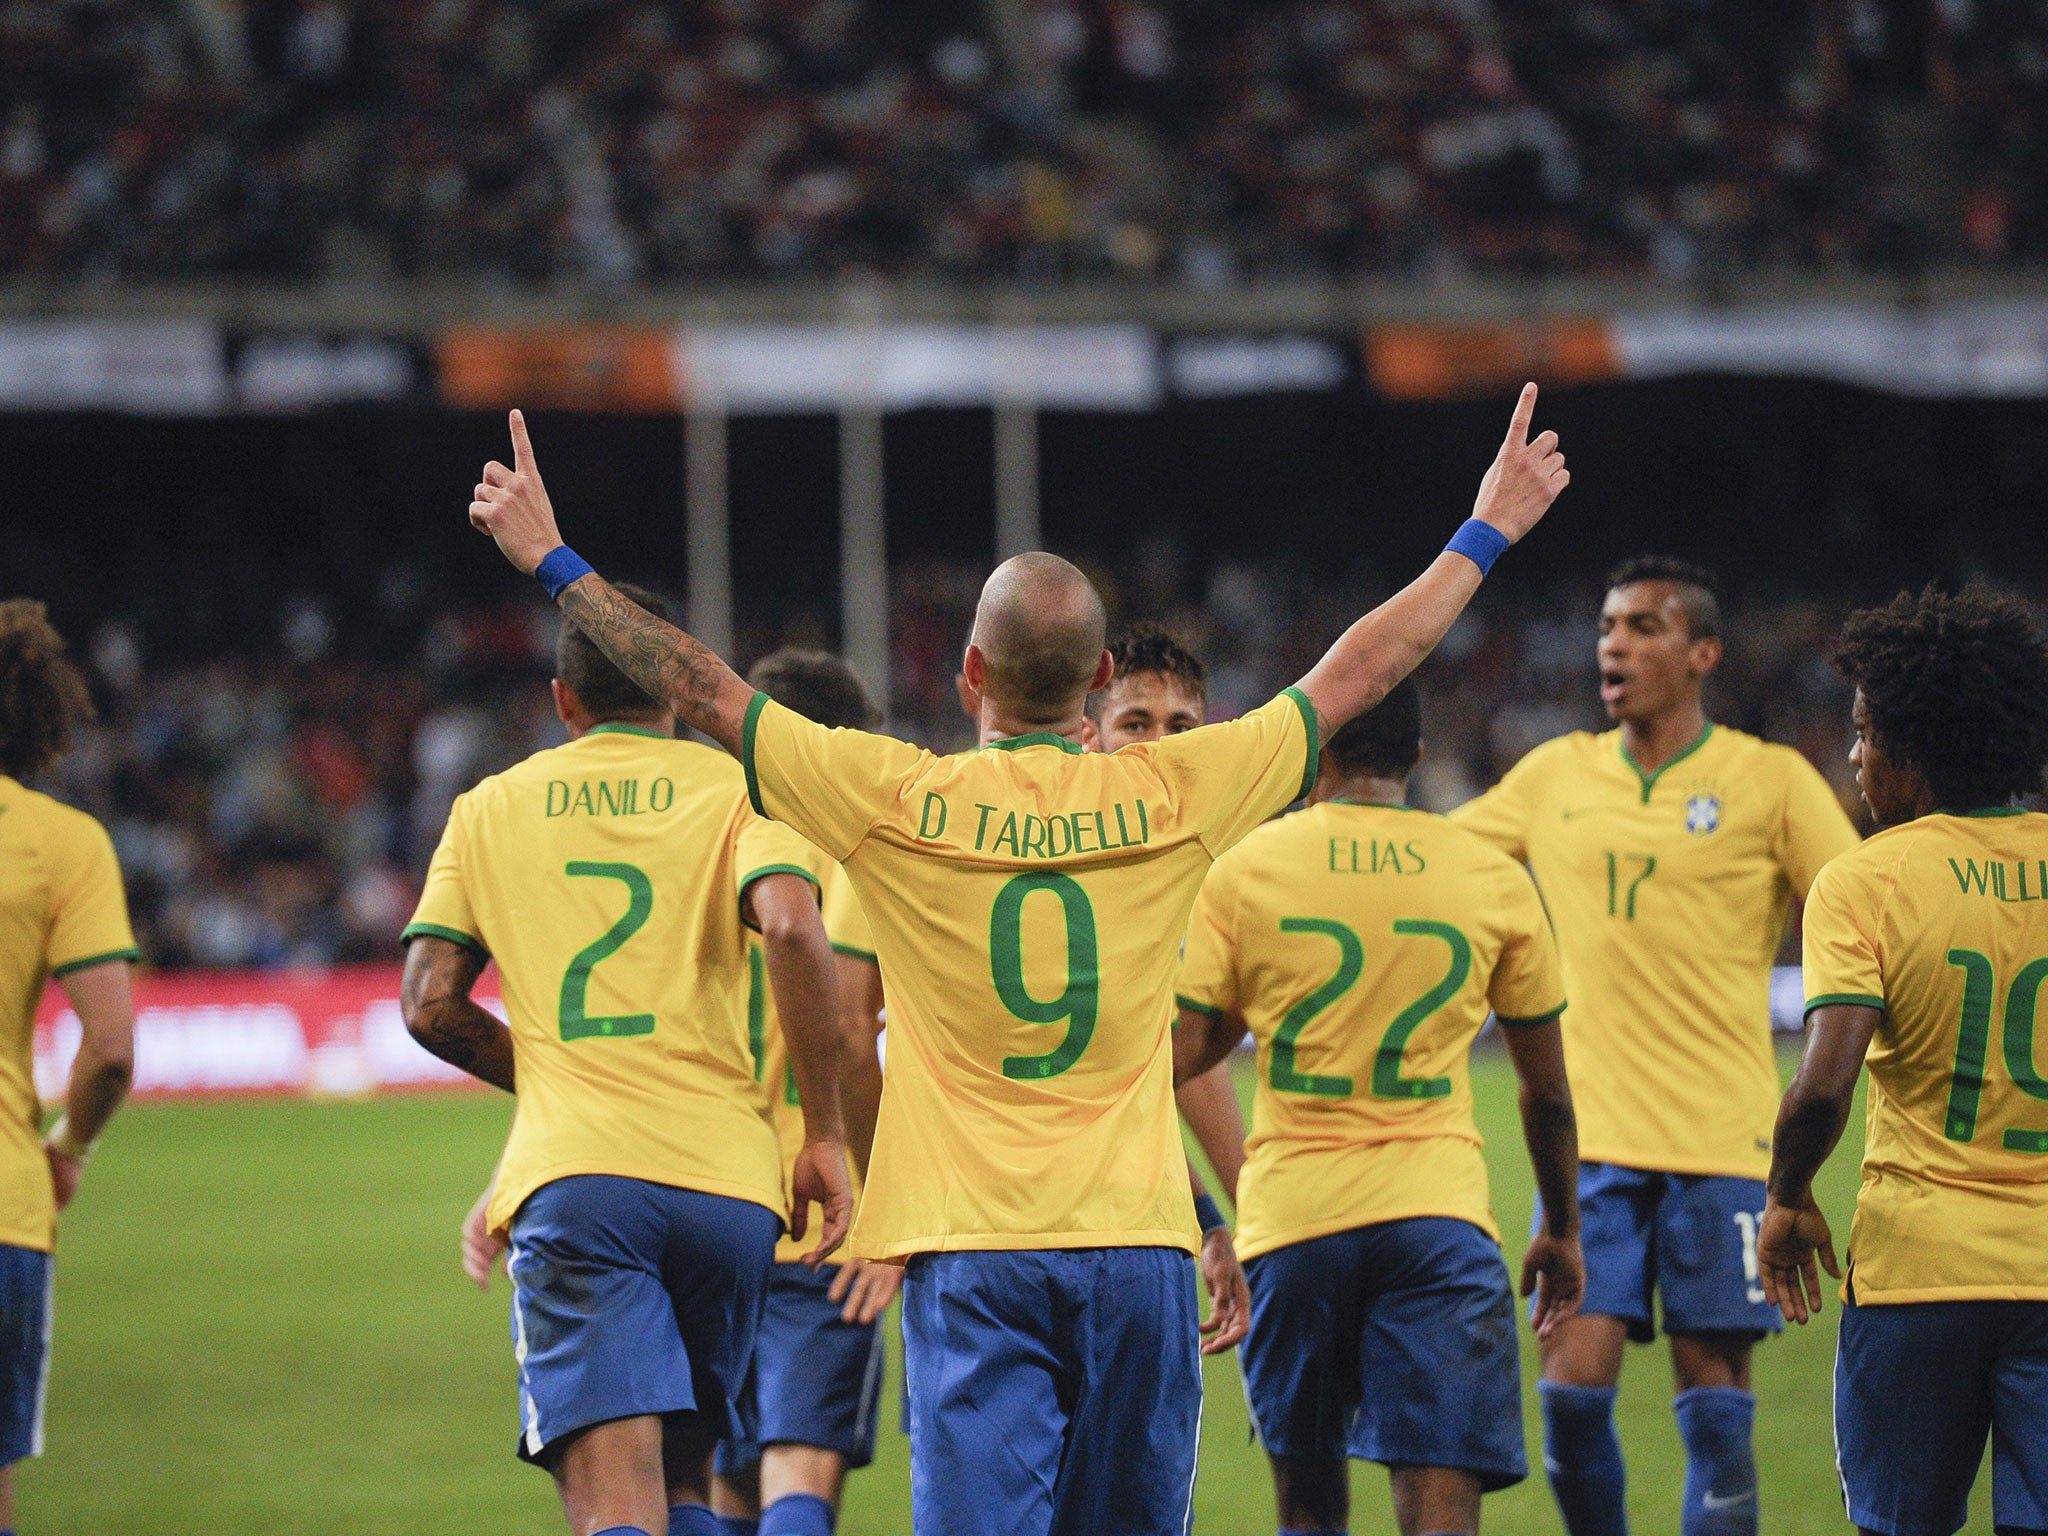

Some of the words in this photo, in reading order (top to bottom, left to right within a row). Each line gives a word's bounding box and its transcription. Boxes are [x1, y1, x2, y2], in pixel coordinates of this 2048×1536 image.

[546, 777, 674, 817] DANILO
[918, 791, 947, 839] D
[974, 799, 1148, 858] TARDELLI
[1328, 836, 1426, 875] ELIAS
[1604, 850, 1656, 920] 17
[558, 861, 656, 1042] 2
[990, 870, 1100, 1081] 9
[1269, 917, 1473, 1099] 22
